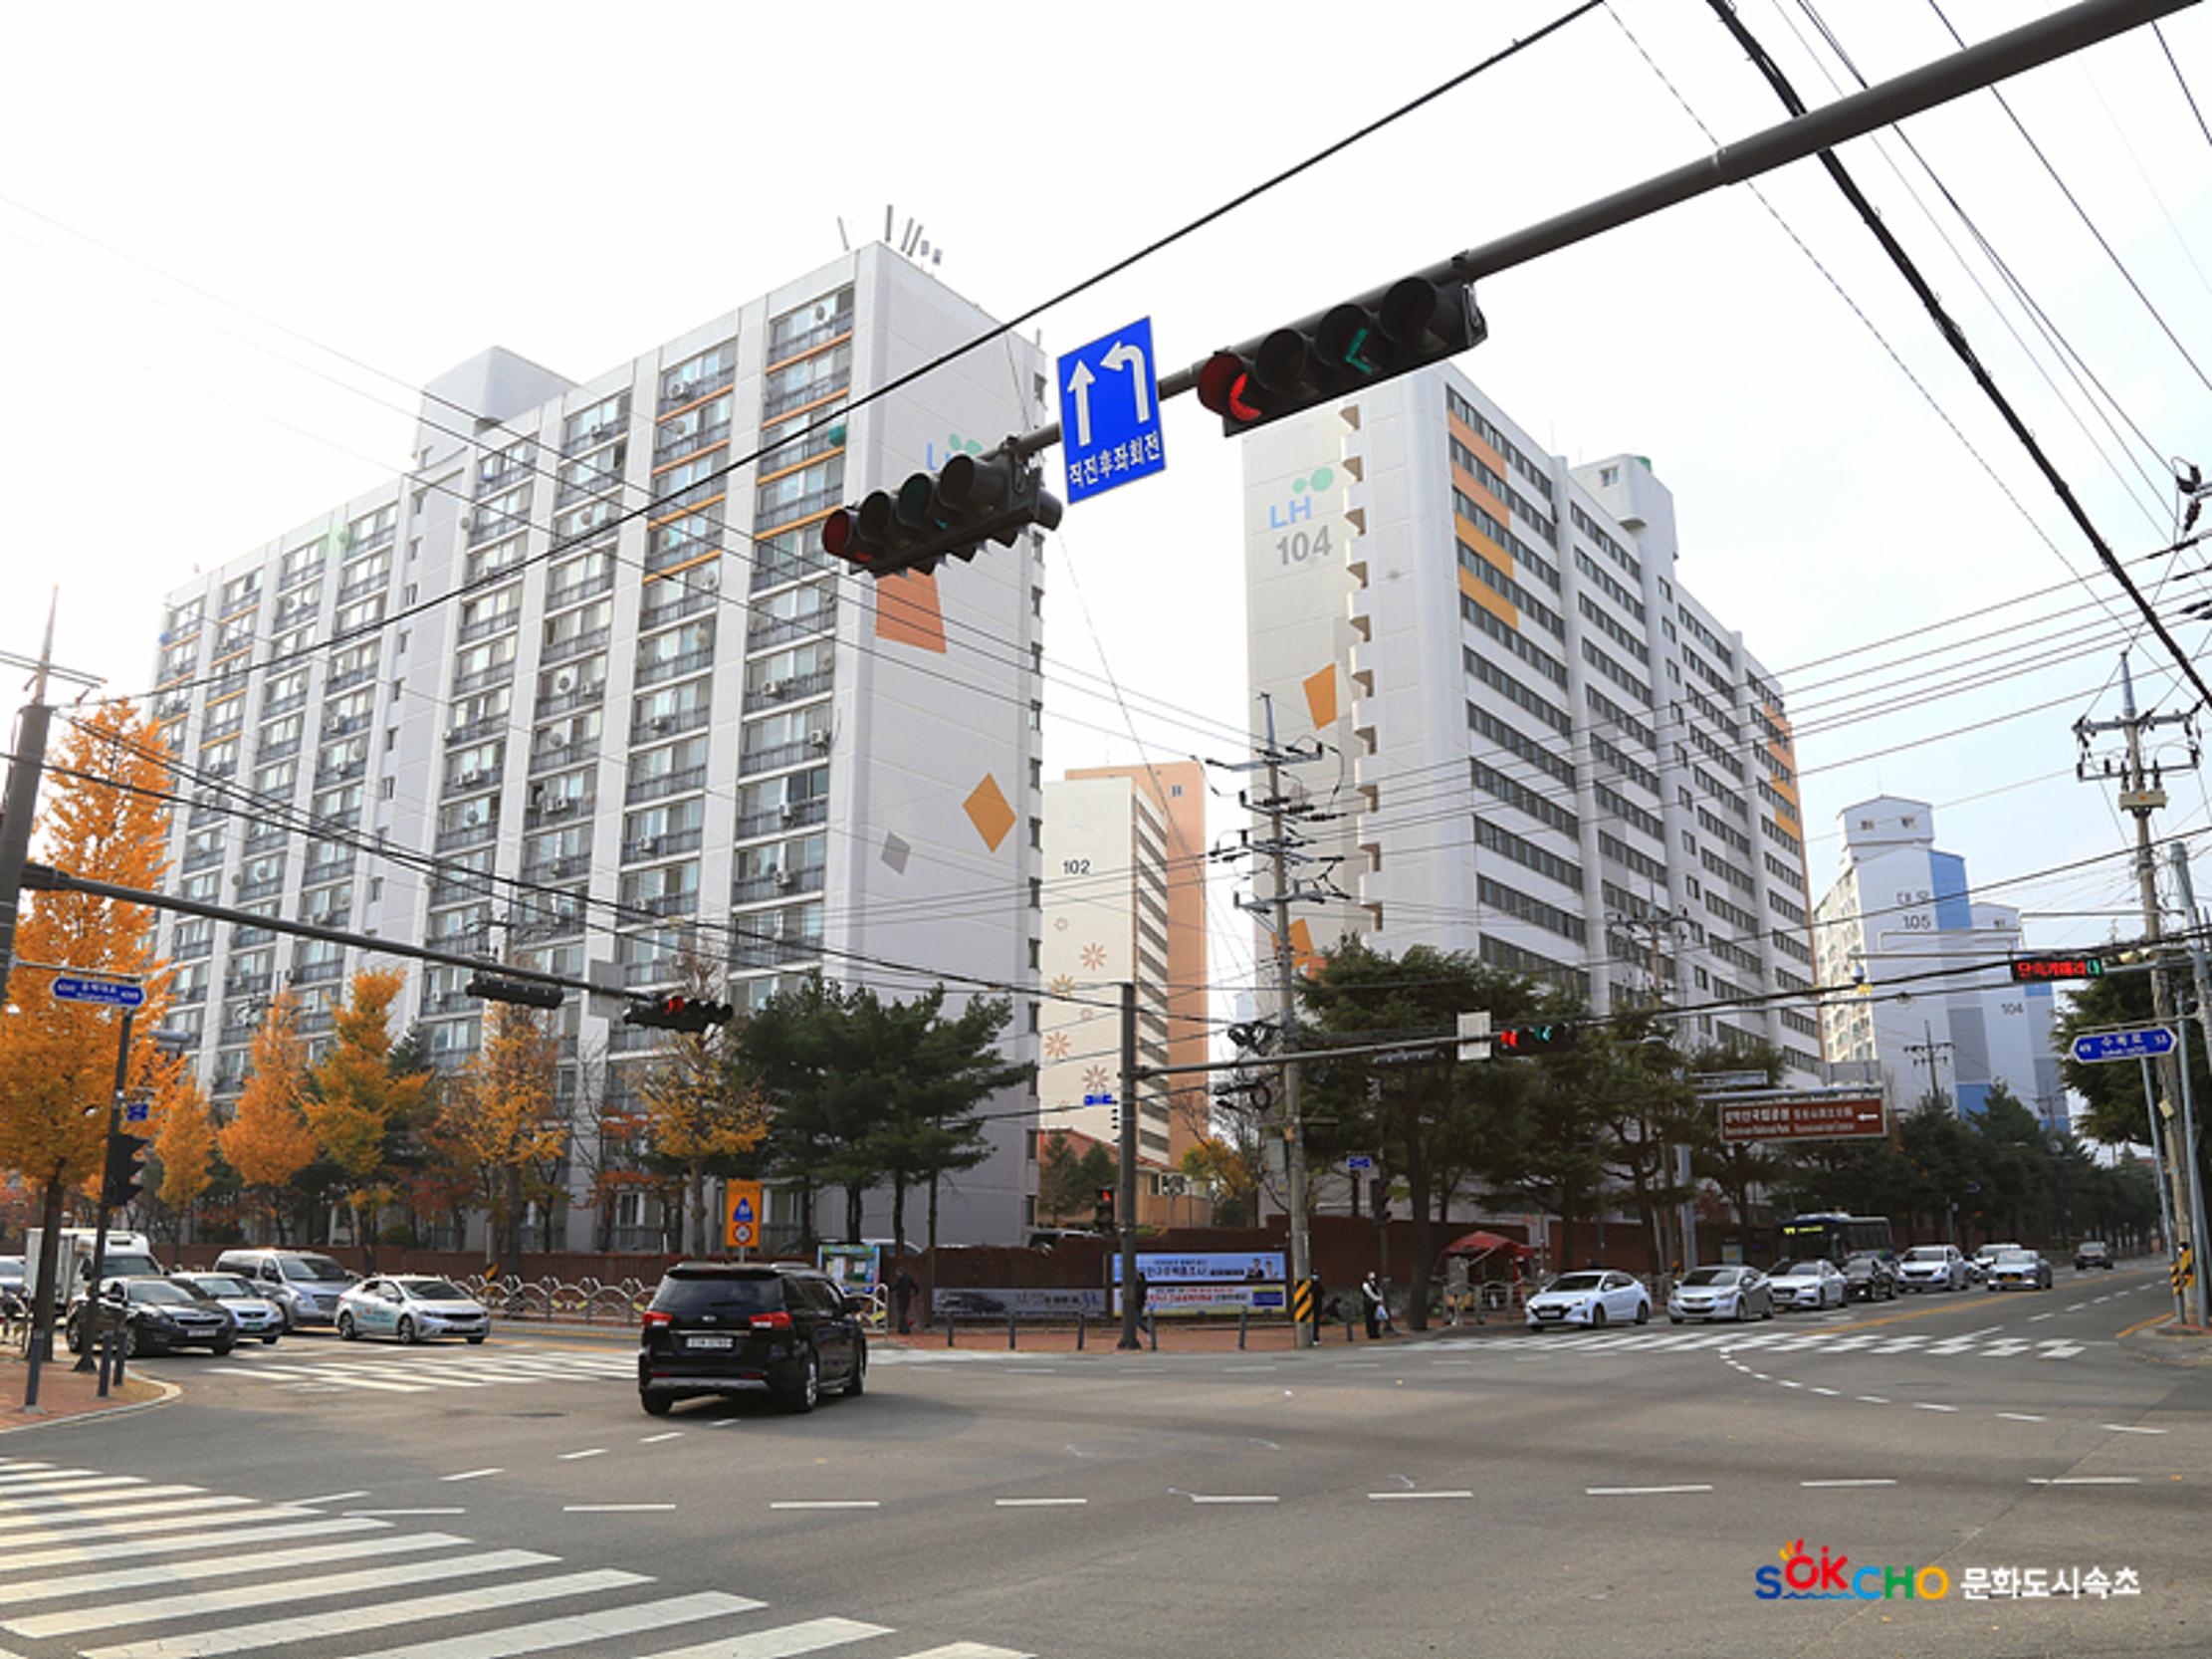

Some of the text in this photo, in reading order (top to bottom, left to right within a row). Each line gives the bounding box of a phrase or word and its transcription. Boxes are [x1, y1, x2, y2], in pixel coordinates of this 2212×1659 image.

[1068, 430, 1161, 490] 직진후좌회전
[1269, 495, 1312, 529] LH
[1276, 525, 1332, 566] 104
[1063, 858, 1091, 875] 102
[1902, 914, 1931, 930] 105
[2001, 1002, 2025, 1017] 104
